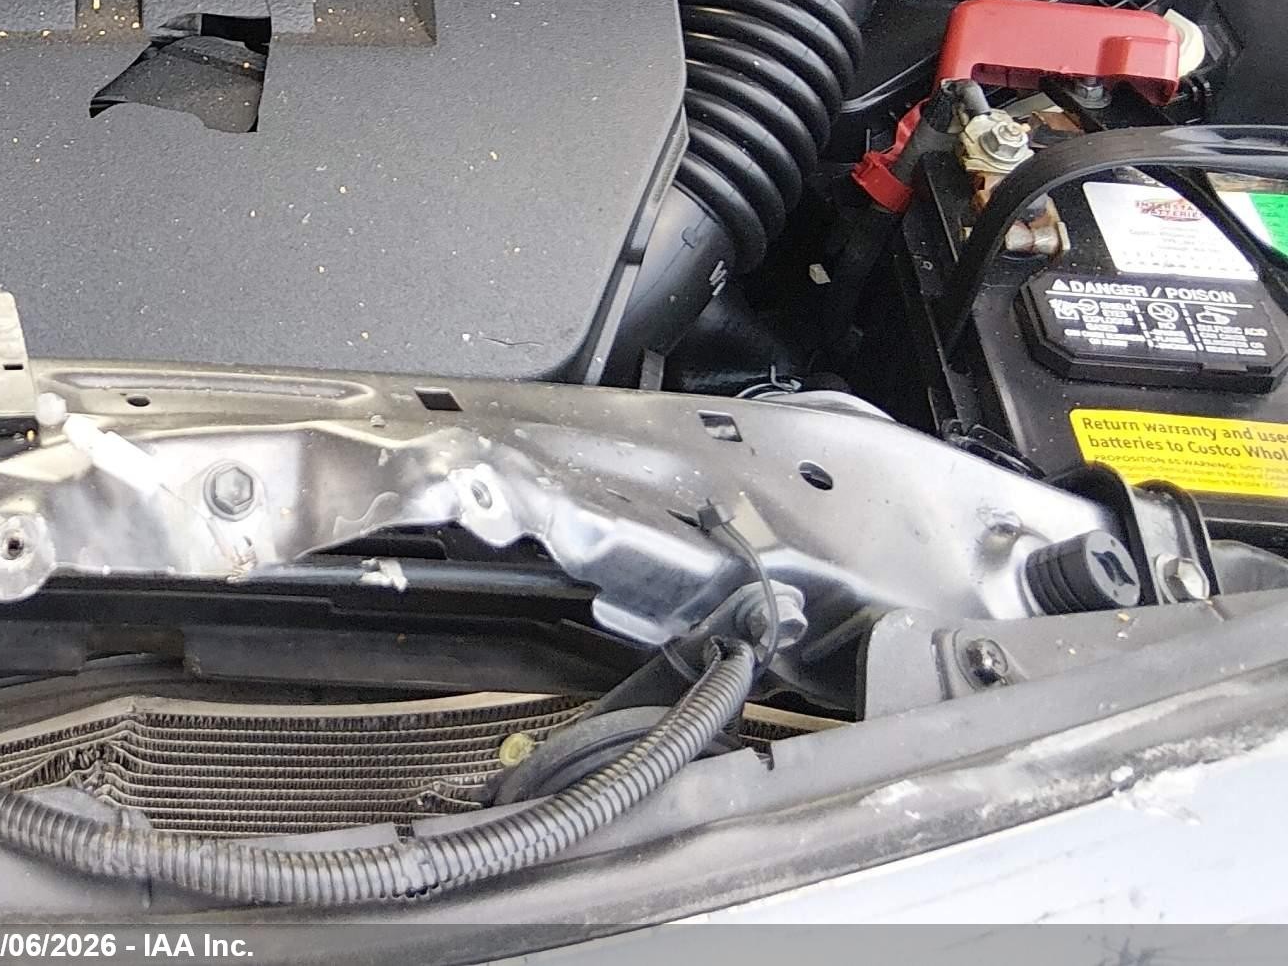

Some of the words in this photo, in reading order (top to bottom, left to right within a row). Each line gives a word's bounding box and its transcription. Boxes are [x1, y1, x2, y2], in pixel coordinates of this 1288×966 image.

[1134, 198, 1198, 211] INTERSTA
[1069, 280, 1147, 298] DANGER
[1165, 287, 1238, 304] POISON
[1082, 417, 1140, 432] Return
[1143, 421, 1217, 441] warranty
[1223, 427, 1254, 440] and
[1257, 431, 1288, 444] use
[1088, 435, 1163, 451] batteries
[1166, 440, 1184, 453] to
